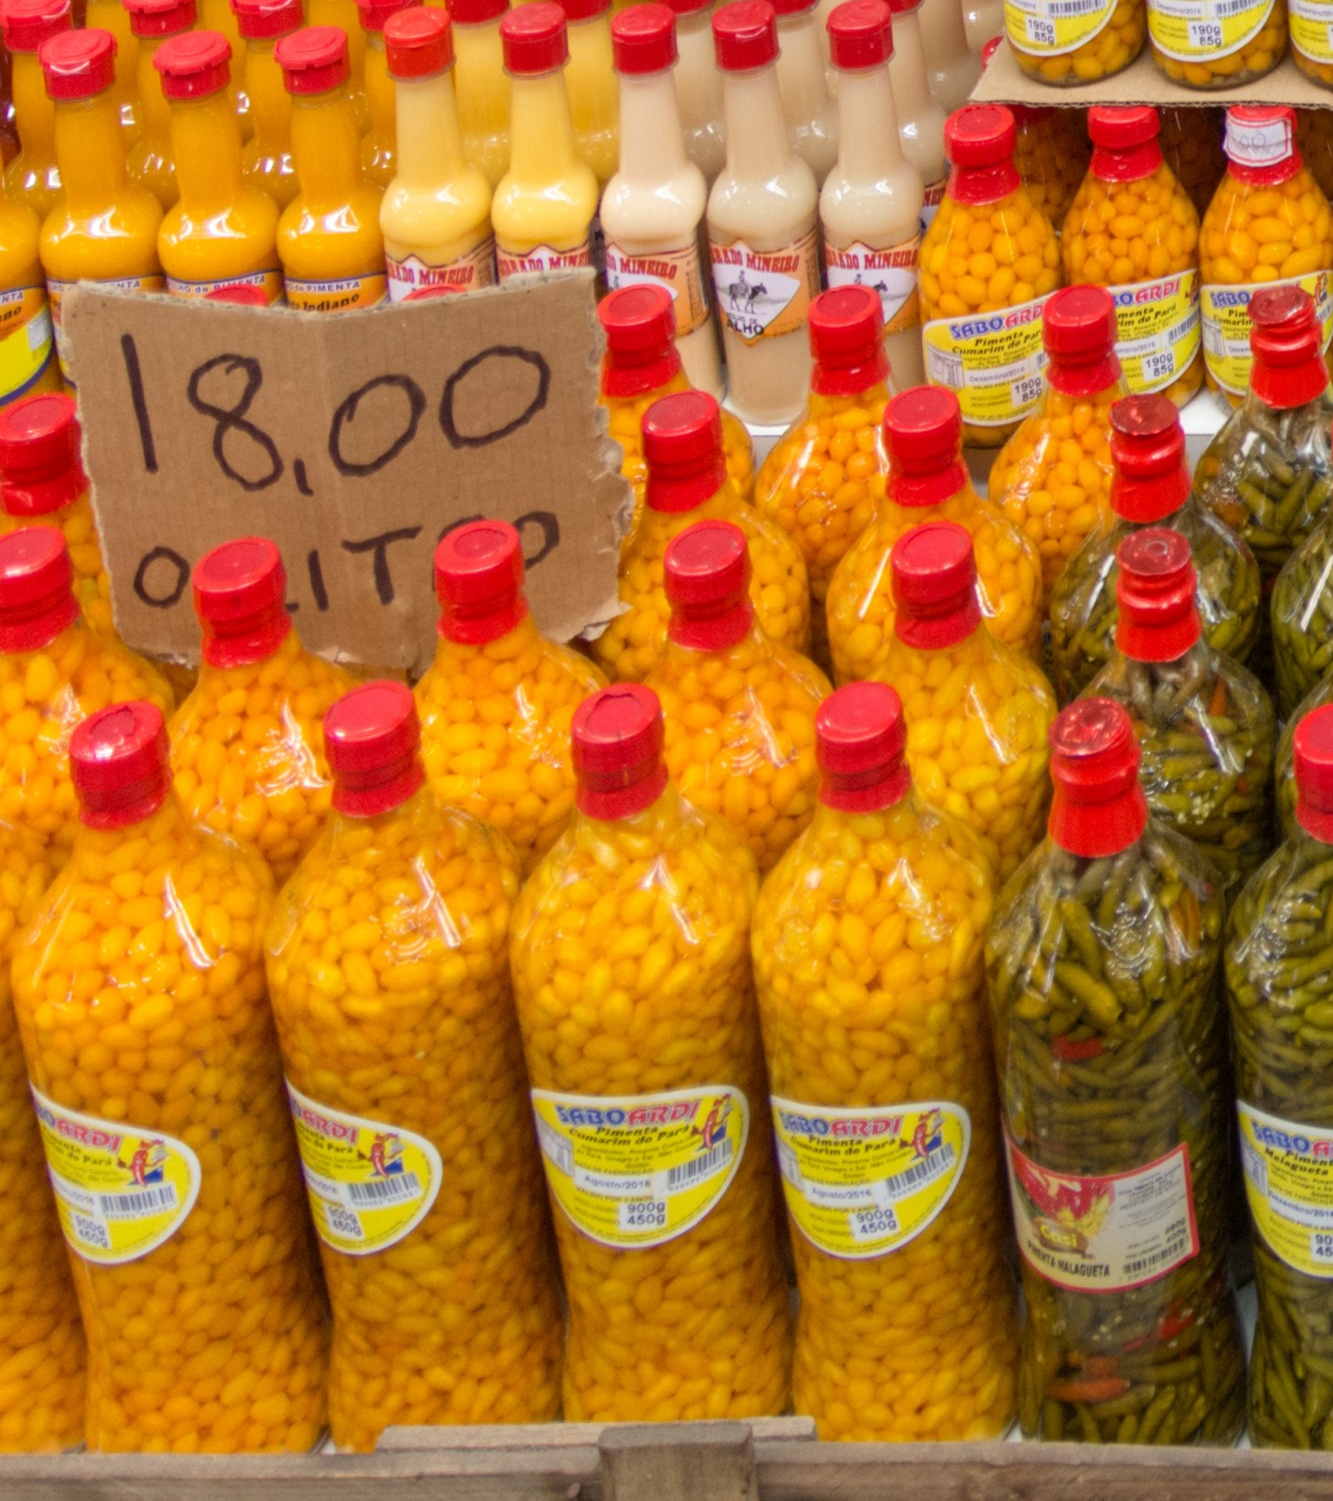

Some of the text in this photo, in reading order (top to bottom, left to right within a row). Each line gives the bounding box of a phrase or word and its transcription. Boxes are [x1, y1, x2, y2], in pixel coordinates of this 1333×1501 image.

[1193, 24, 1221, 36] 190g
[746, 253, 800, 272] MINEIRO
[726, 320, 766, 336] ALHO
[284, 510, 560, 614] ITO
[556, 1101, 699, 1127] SABOARDI
[627, 1202, 666, 1215] 900g
[626, 1213, 666, 1227] 450g
[1057, 1259, 1111, 1279] MALAGUETA
